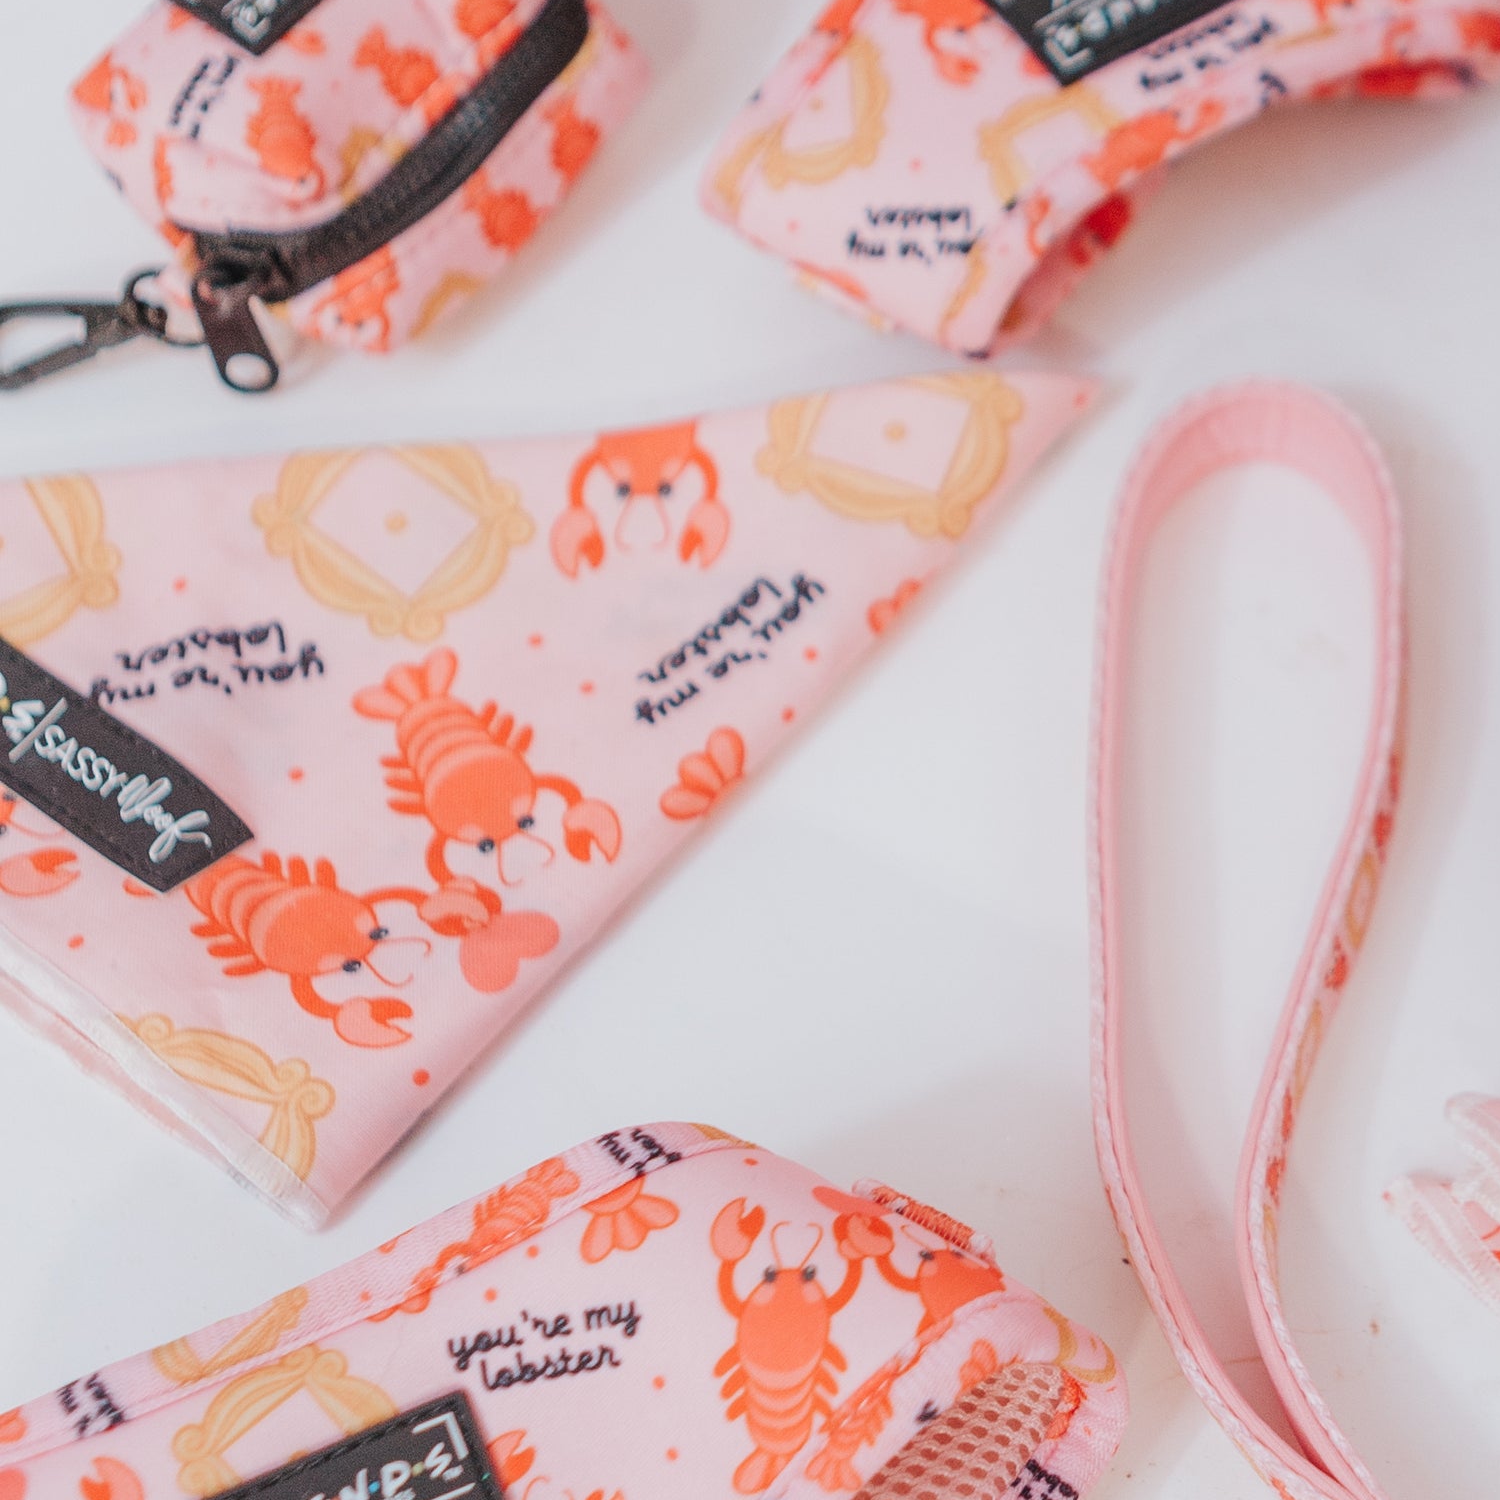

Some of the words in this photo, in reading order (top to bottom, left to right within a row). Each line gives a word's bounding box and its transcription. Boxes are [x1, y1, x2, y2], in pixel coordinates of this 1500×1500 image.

[34, 722, 130, 800] SASSY
[447, 1308, 574, 1372] you're
[583, 1299, 643, 1338] my
[480, 1342, 622, 1392] lobster
